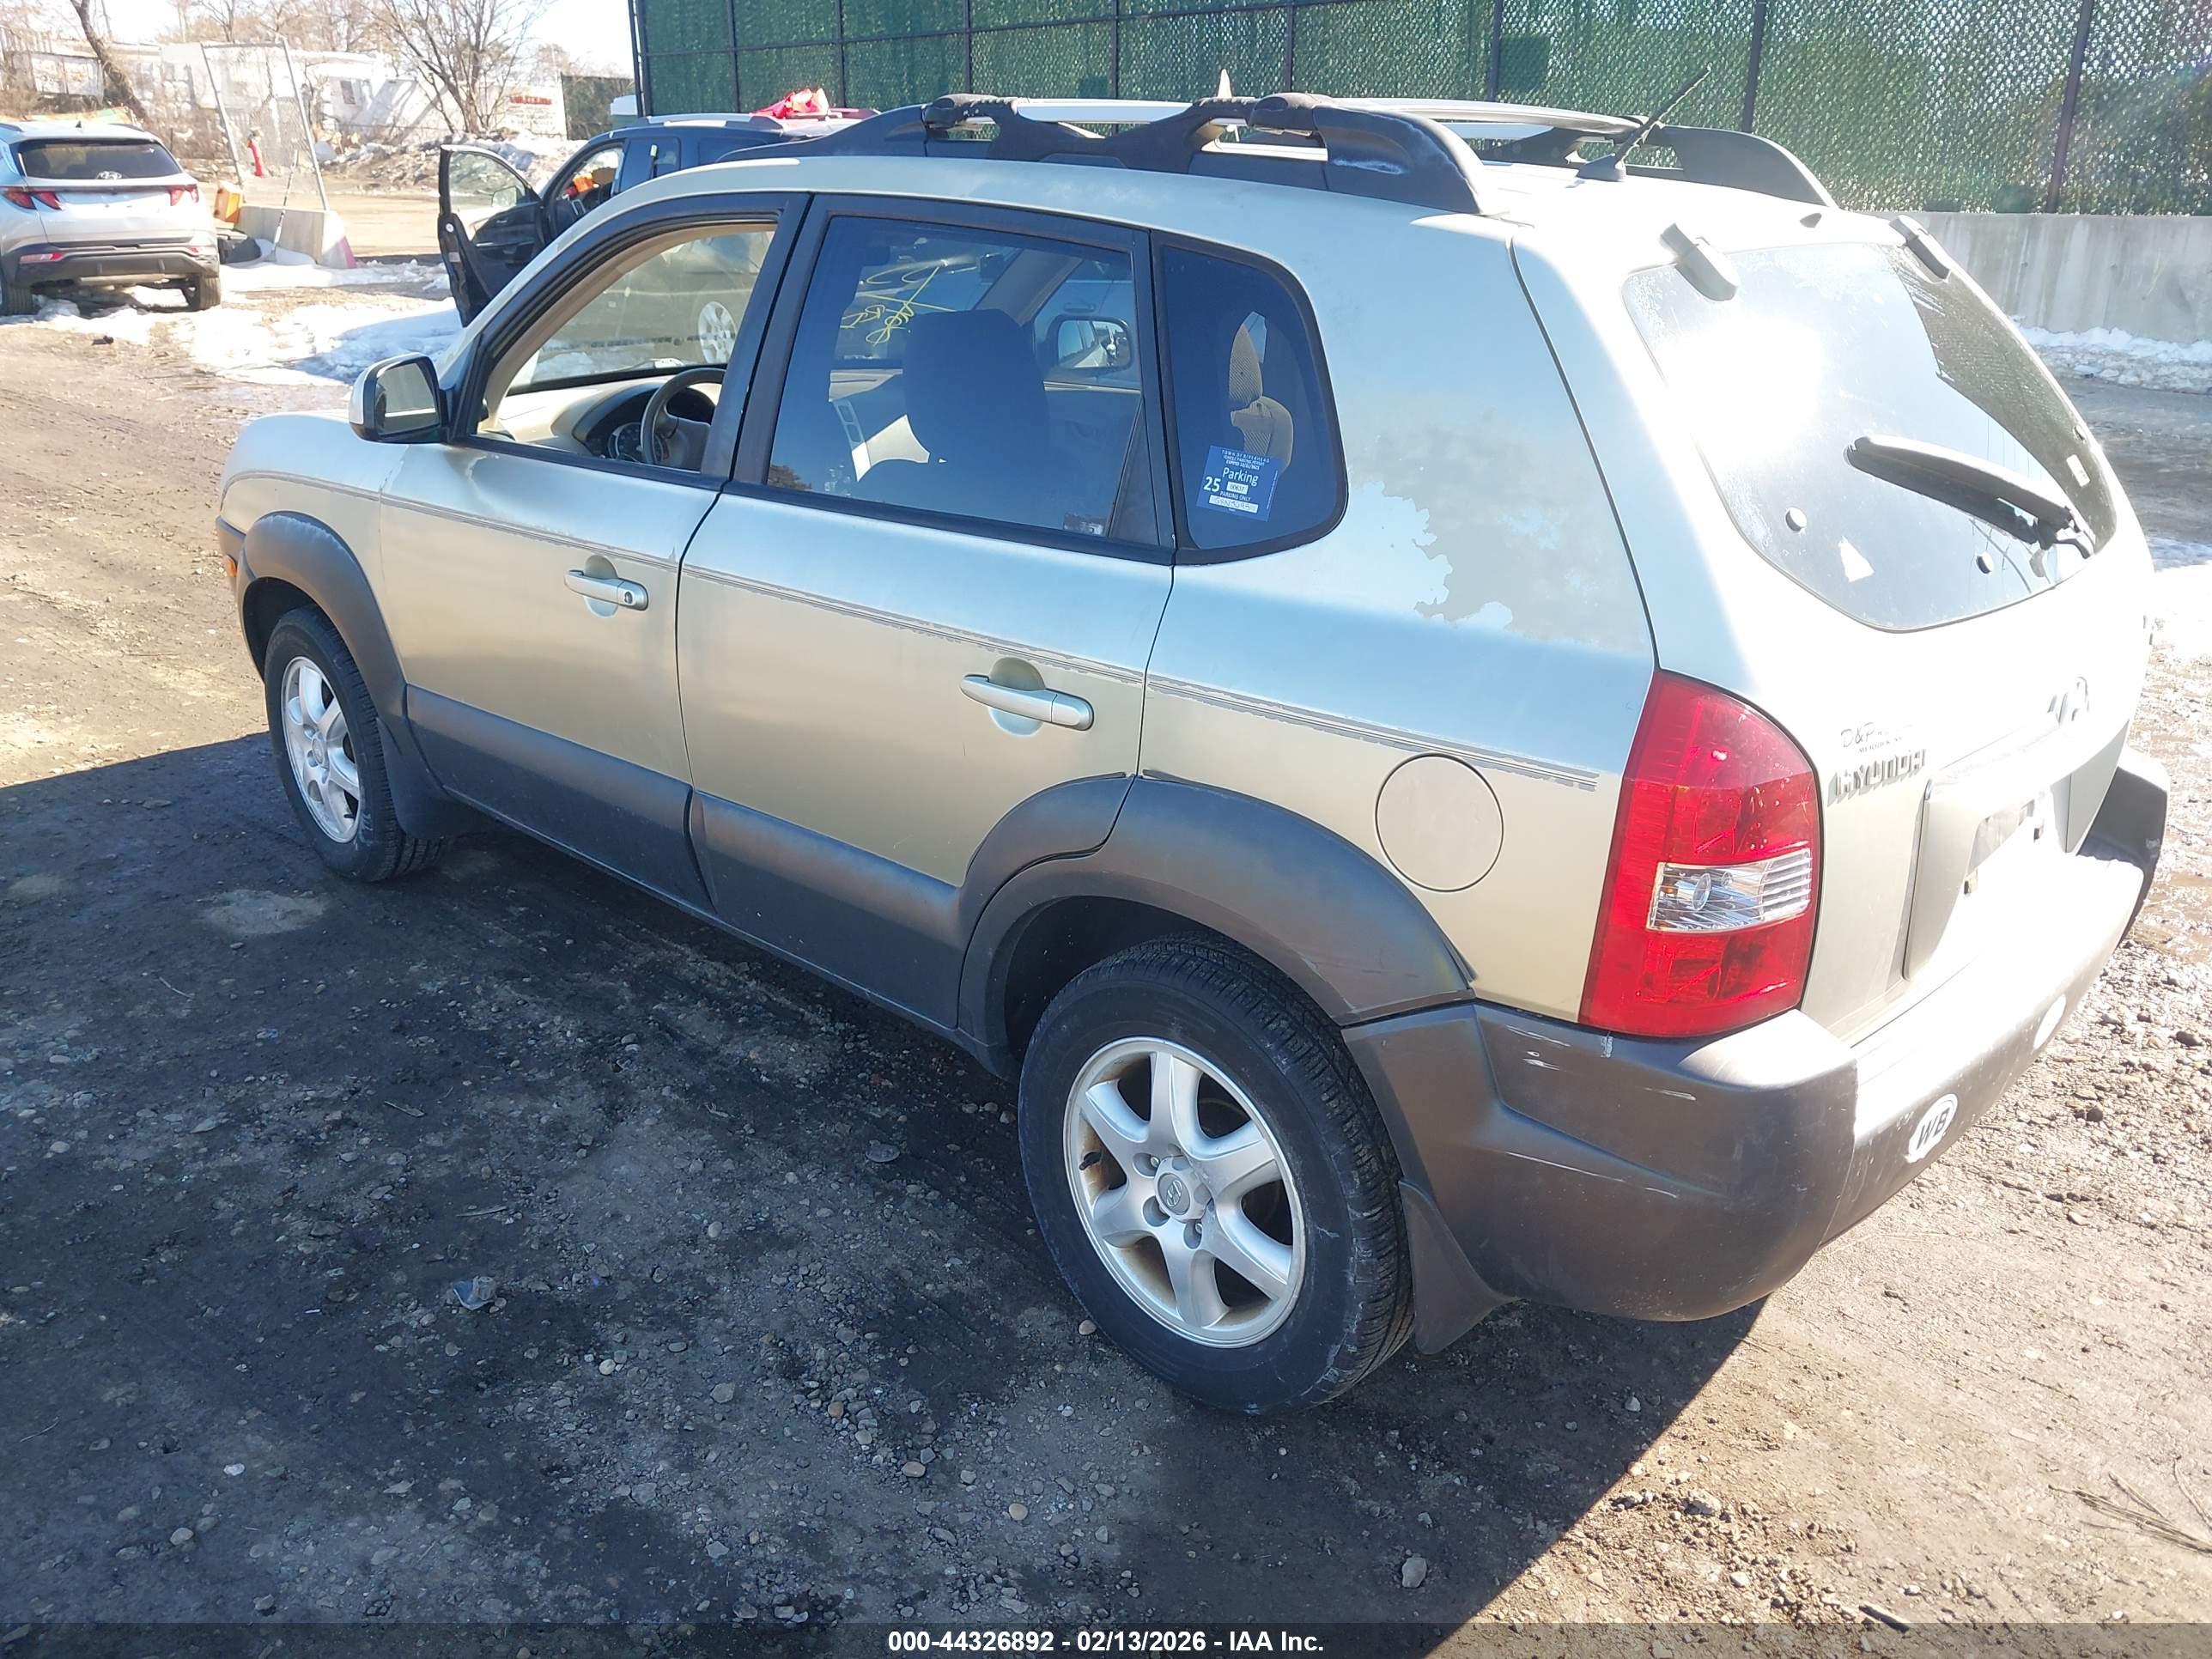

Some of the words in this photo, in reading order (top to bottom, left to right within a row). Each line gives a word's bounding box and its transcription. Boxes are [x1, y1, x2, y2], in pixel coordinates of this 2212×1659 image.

[1203, 476, 1221, 492] 25
[1223, 467, 1259, 487] Parking
[1219, 490, 1239, 500] PARKING
[1916, 1107, 1951, 1151] WB
